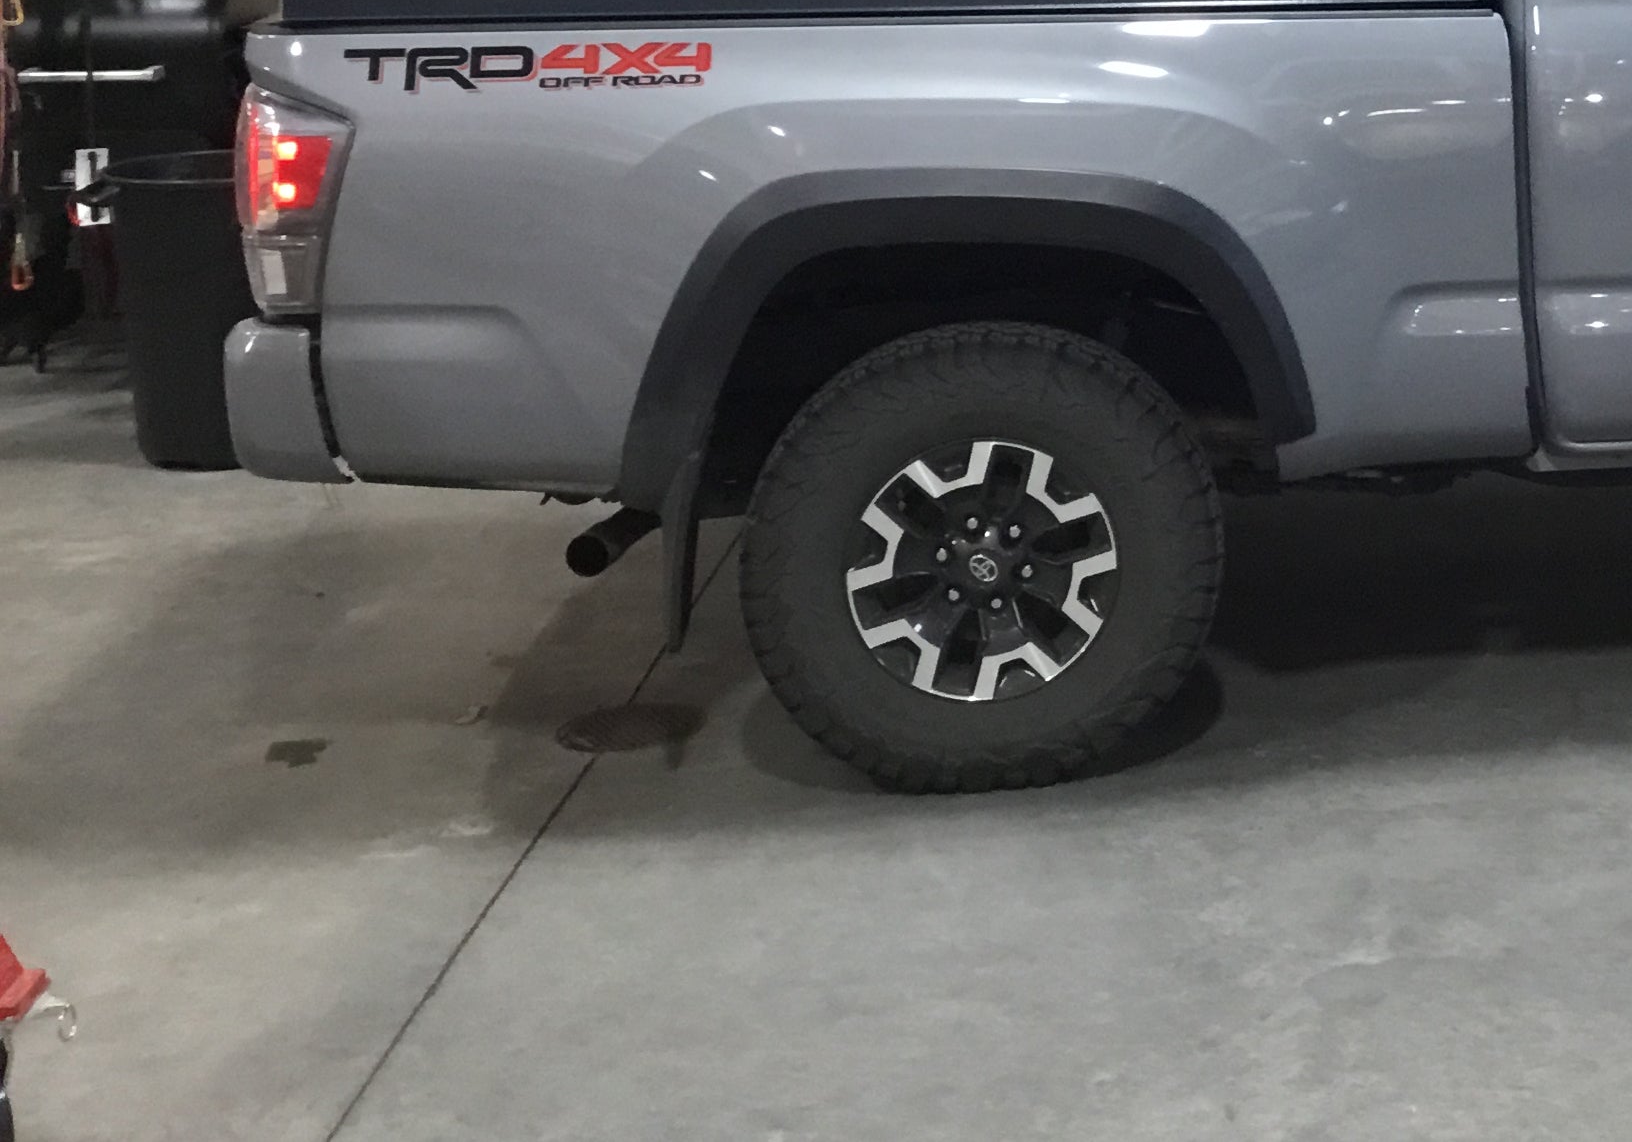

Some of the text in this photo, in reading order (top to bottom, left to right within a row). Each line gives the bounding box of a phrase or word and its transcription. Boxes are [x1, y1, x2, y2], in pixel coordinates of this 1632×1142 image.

[343, 45, 536, 92] TRD
[538, 73, 703, 90] OFF ROAD
